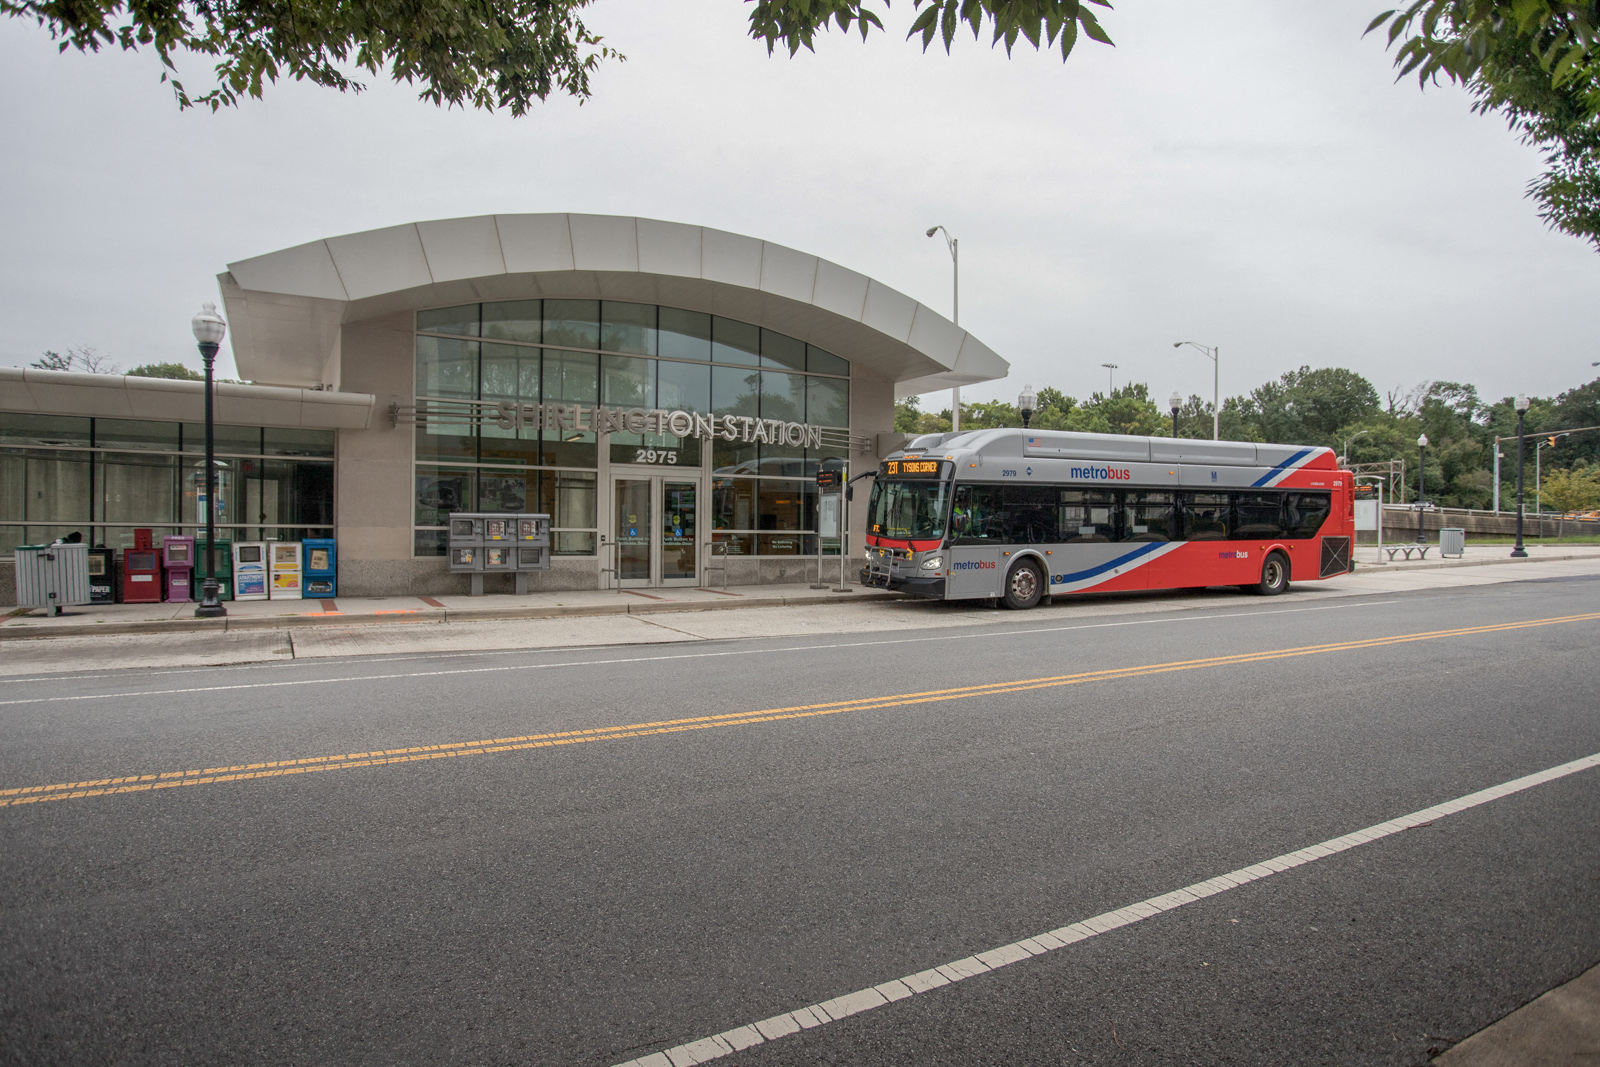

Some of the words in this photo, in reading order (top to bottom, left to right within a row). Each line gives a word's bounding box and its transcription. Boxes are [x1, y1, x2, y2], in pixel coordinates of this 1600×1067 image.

[496, 400, 715, 440] SHIRLINGTON
[720, 414, 822, 450] STATION
[636, 449, 678, 465] 2975
[887, 461, 899, 475] 23T
[902, 462, 920, 473] TYSONS
[920, 461, 937, 473] CORNER
[1002, 469, 1017, 477] 2979
[1070, 465, 1131, 480] metrobus
[1218, 550, 1249, 559] metrobus
[953, 559, 996, 570] metrobus
